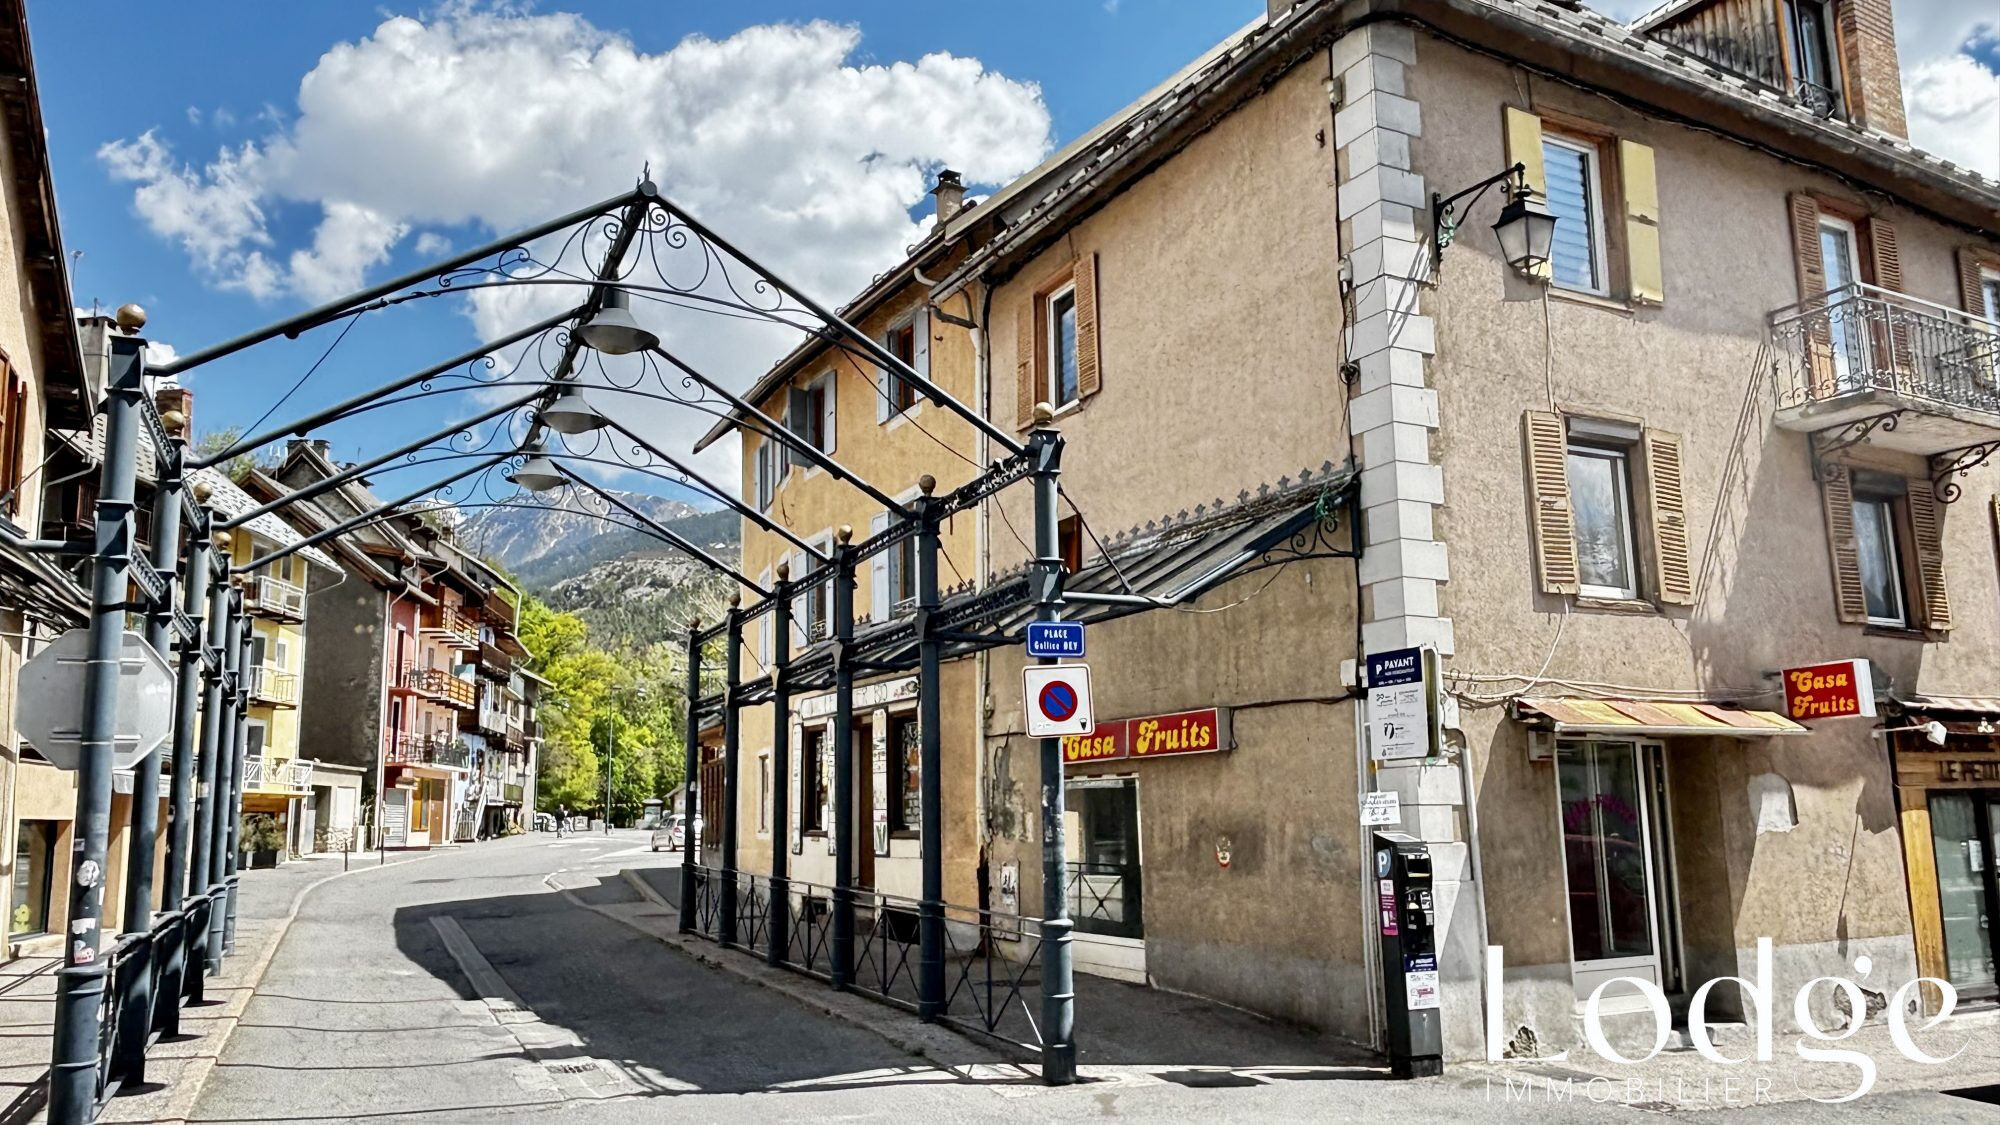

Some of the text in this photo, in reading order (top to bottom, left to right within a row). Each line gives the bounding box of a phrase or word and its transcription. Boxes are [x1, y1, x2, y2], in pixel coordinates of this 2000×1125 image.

[1044, 629, 1068, 639] PLACE
[1384, 656, 1414, 670] PAYANT
[1790, 671, 1848, 692] Casa
[1792, 695, 1856, 718] Fruits
[1062, 719, 1210, 760] Casa Fruits
